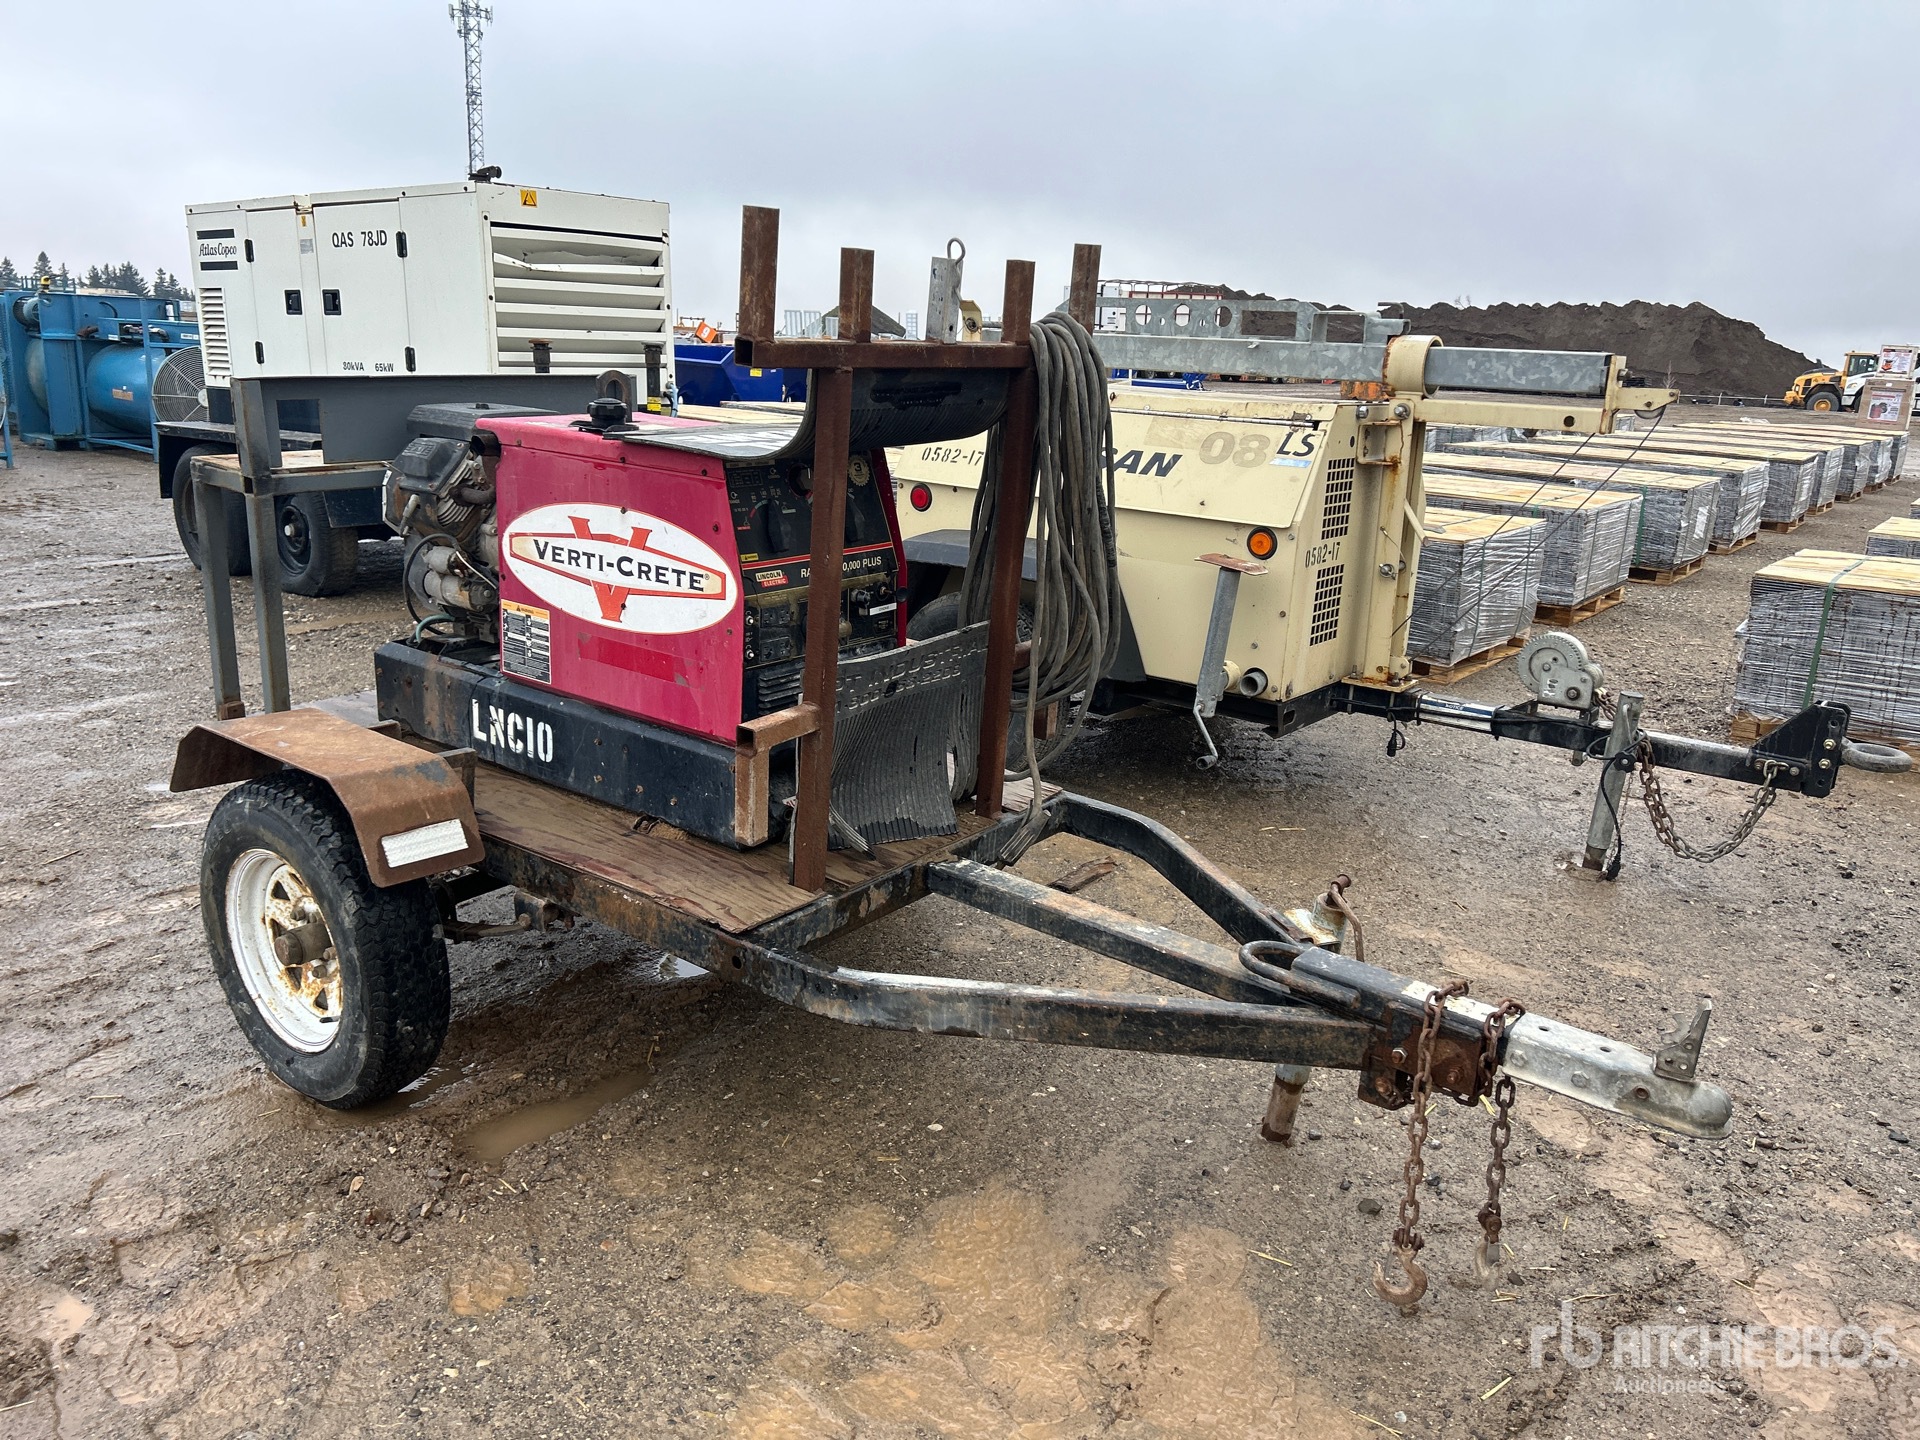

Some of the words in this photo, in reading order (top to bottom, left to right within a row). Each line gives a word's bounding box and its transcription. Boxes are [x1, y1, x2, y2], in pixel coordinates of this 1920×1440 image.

[332, 231, 354, 248] QAS
[360, 229, 388, 247] 78JD
[374, 362, 394, 373] 65kW
[1276, 431, 1316, 457] LS
[921, 446, 985, 466] 0582-17
[842, 559, 861, 572] 0,000
[862, 556, 882, 568] PLUS
[1305, 541, 1341, 569] 0582-17
[533, 538, 705, 592] VERTI-CRETE
[757, 570, 782, 580] LINCOLN
[763, 578, 787, 587] ELECTRIC
